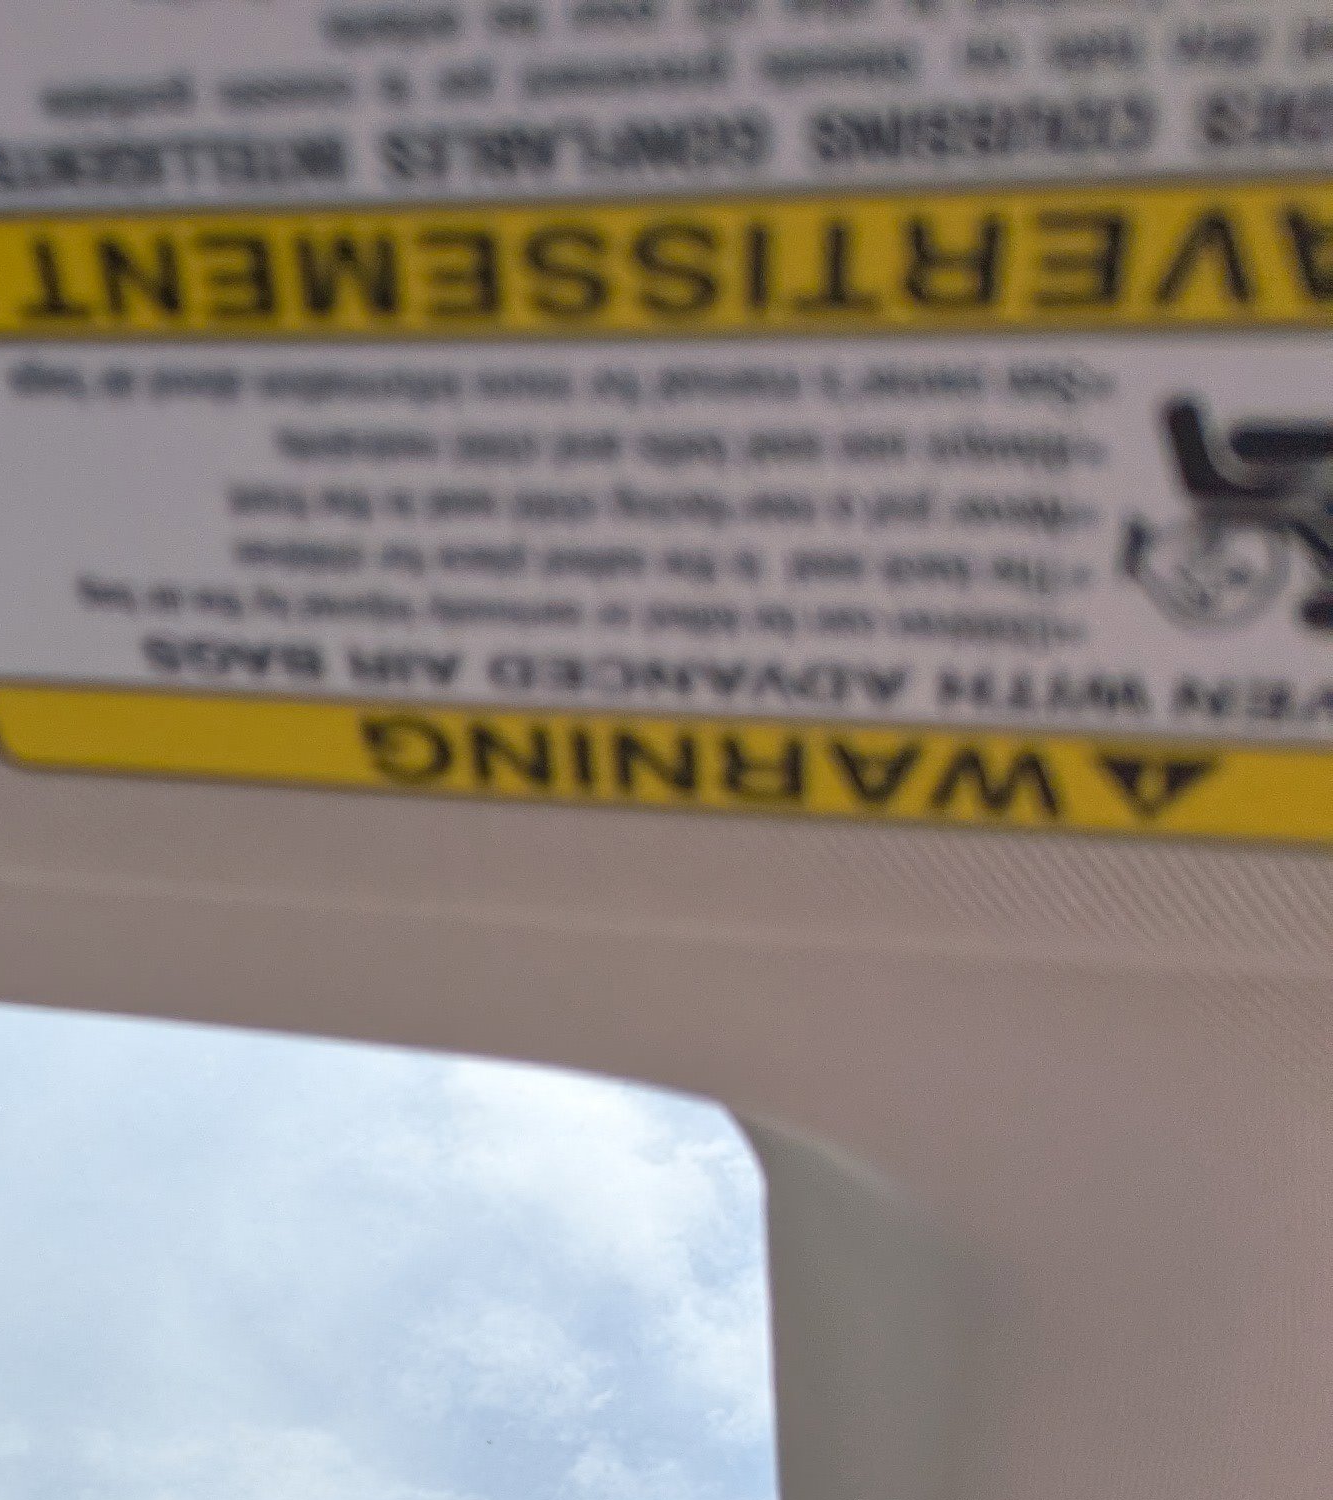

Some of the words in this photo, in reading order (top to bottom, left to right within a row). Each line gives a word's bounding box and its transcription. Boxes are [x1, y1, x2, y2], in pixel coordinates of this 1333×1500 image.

[13, 204, 1333, 322] AVERTISSEMENT
[141, 635, 326, 682] BAGS
[347, 650, 463, 687] AIR
[486, 654, 911, 709] ADVANCED
[933, 668, 1149, 716] WITH
[360, 716, 1061, 822] WARNING
